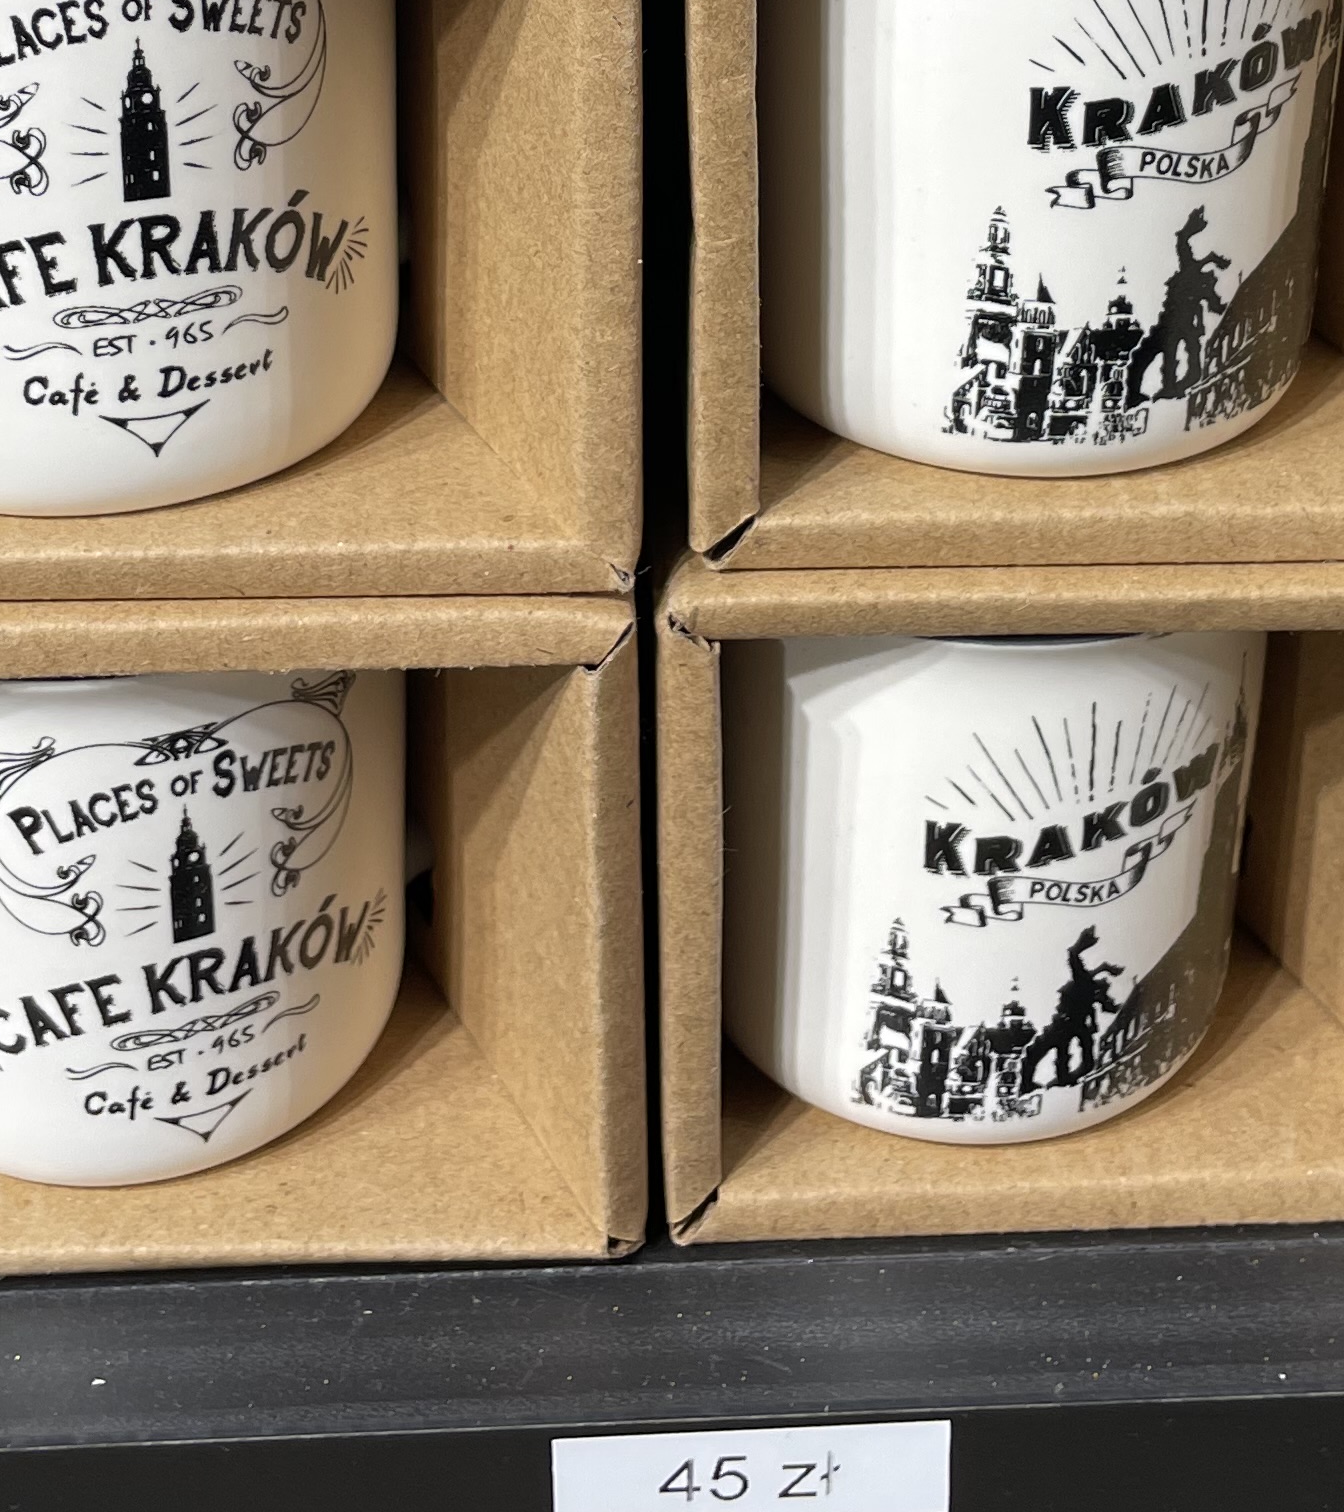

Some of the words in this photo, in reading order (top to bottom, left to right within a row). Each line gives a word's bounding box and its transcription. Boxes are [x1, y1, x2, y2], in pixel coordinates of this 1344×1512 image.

[1026, 9, 1322, 153] KRAKÓW
[1138, 150, 1231, 180] POLSKA
[87, 189, 351, 288] KRAKÓW
[165, 321, 215, 350] 965
[23, 373, 99, 417] Café
[118, 374, 142, 403] &
[157, 348, 274, 399] Dessert
[7, 778, 159, 855] PLACES
[170, 770, 203, 798] OF
[212, 740, 336, 799] SWEETS
[1028, 879, 1122, 904] POLSKA
[141, 894, 370, 1015] KRAKÓW
[84, 1086, 153, 1121] Café
[171, 1081, 192, 1106] &
[206, 1033, 306, 1097] Dessert
[211, 1027, 255, 1060] 965
[658, 1455, 751, 1502] 45
[778, 1449, 841, 1498] zł
